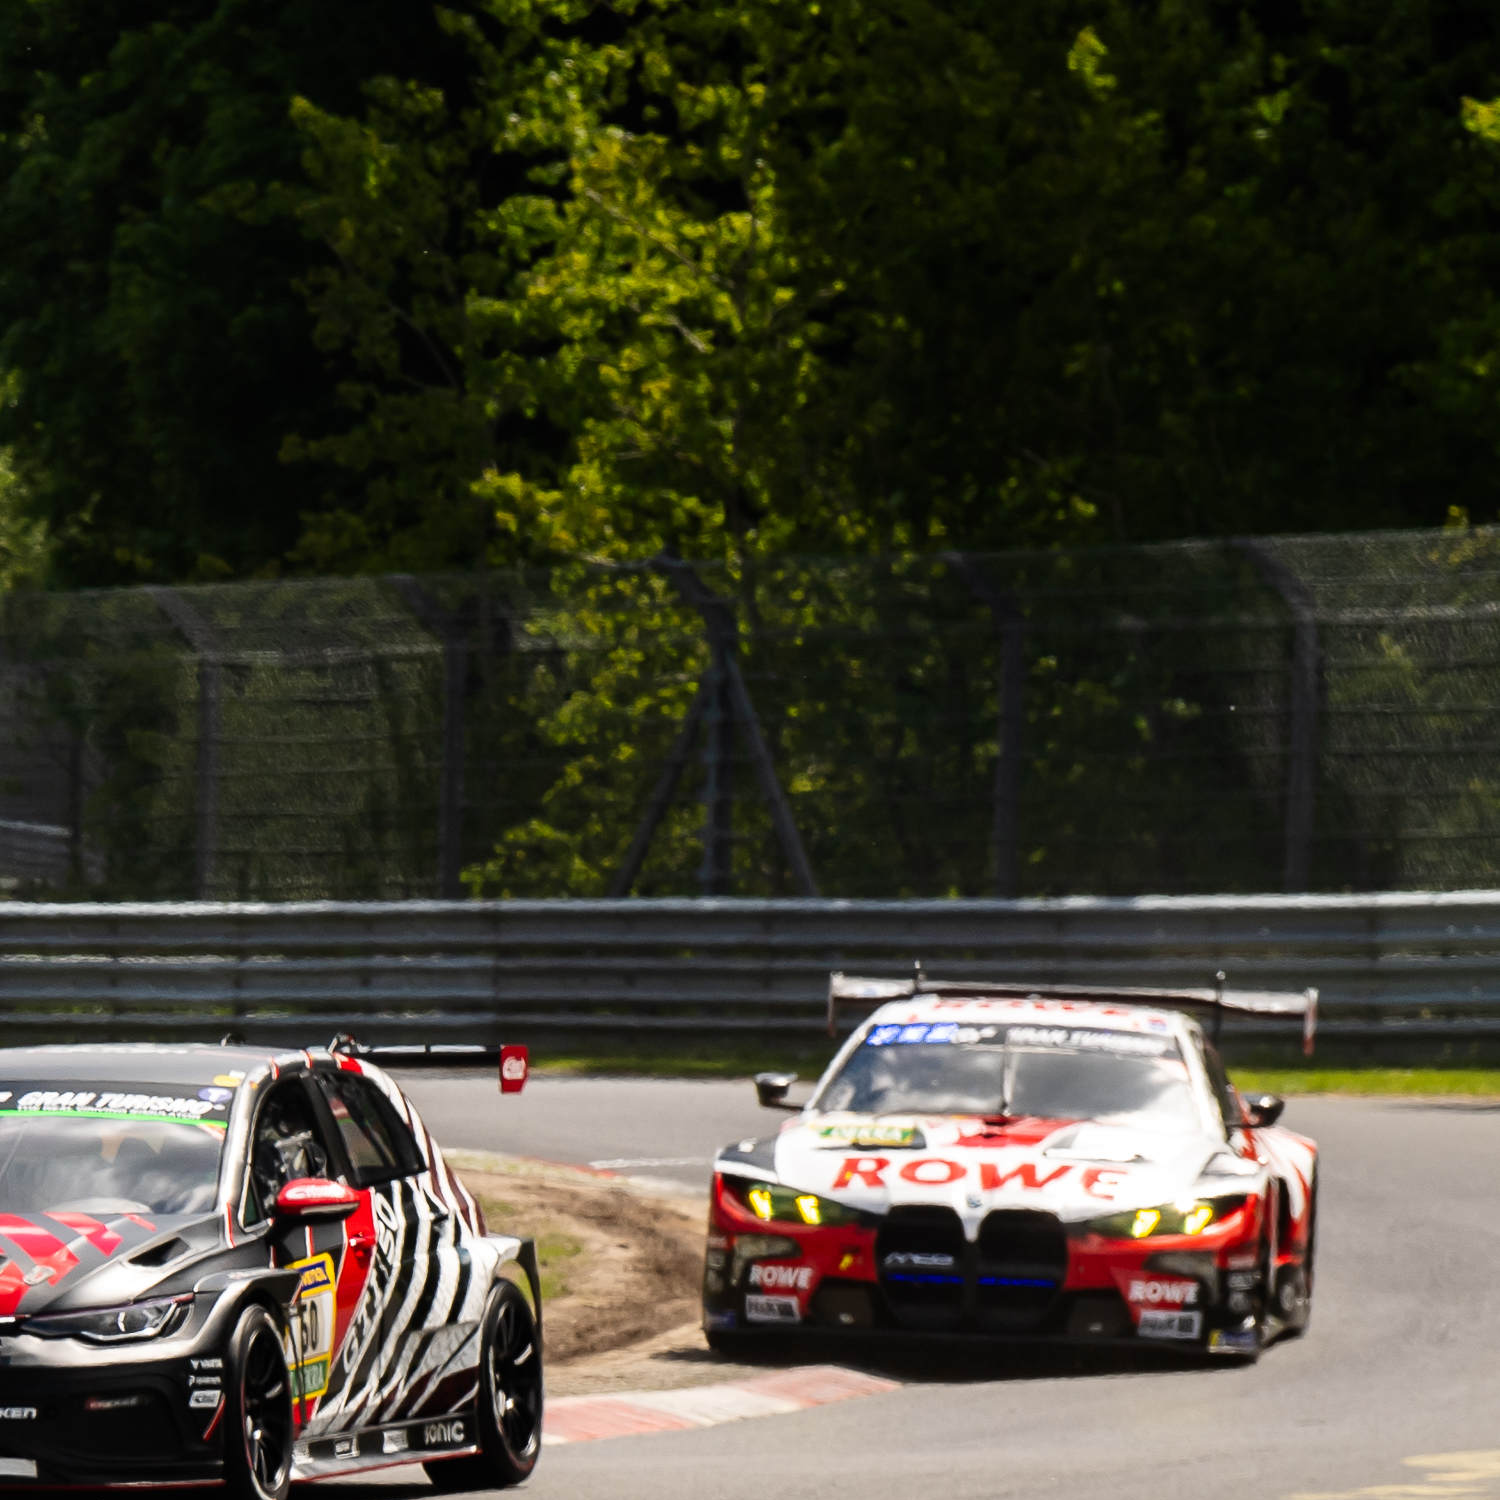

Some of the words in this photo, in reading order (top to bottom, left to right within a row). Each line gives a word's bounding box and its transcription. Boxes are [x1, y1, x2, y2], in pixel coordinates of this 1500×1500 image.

[18, 1091, 96, 1107] GRAN
[832, 1156, 1128, 1200] ROWE
[750, 1264, 813, 1289] ROWE
[1129, 1279, 1199, 1304] ROWE
